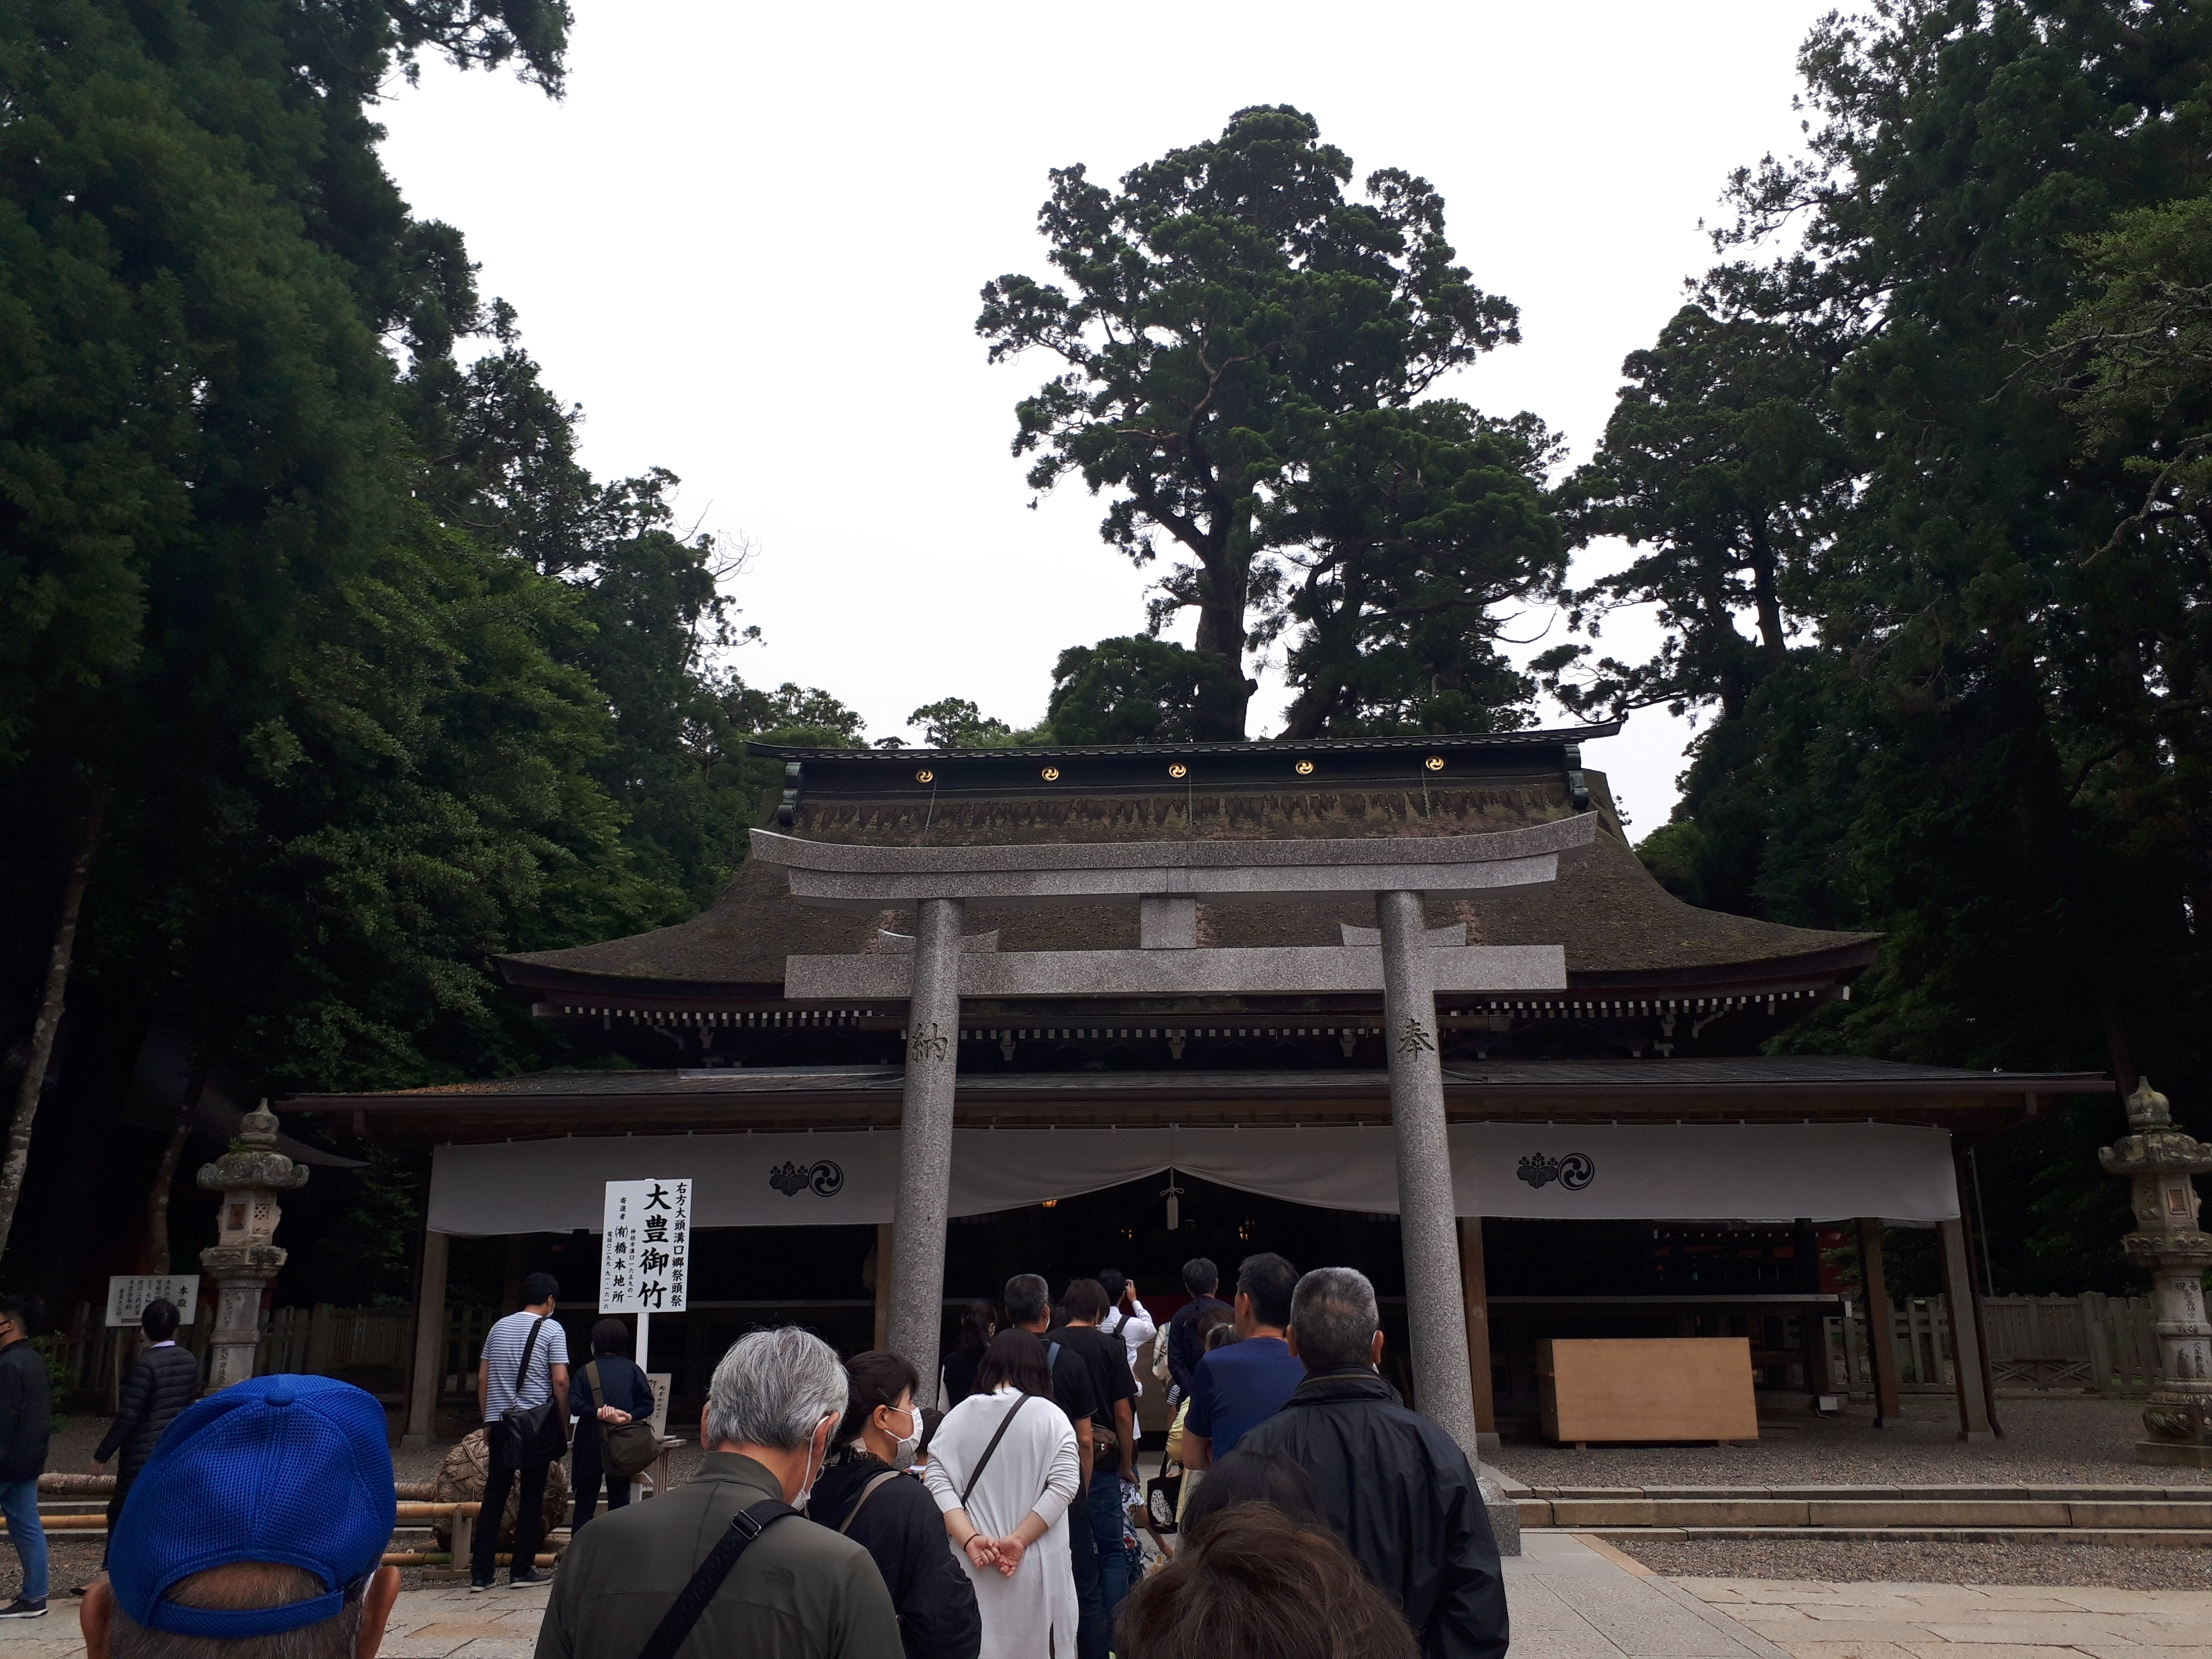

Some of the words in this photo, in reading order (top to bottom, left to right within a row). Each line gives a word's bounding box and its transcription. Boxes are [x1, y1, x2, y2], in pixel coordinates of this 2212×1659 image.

[912, 1022, 948, 1063] 納
[637, 1184, 672, 1309] 大豊御竹
[670, 1182, 687, 1307] 右方大頭溝口郷祭頭祭
